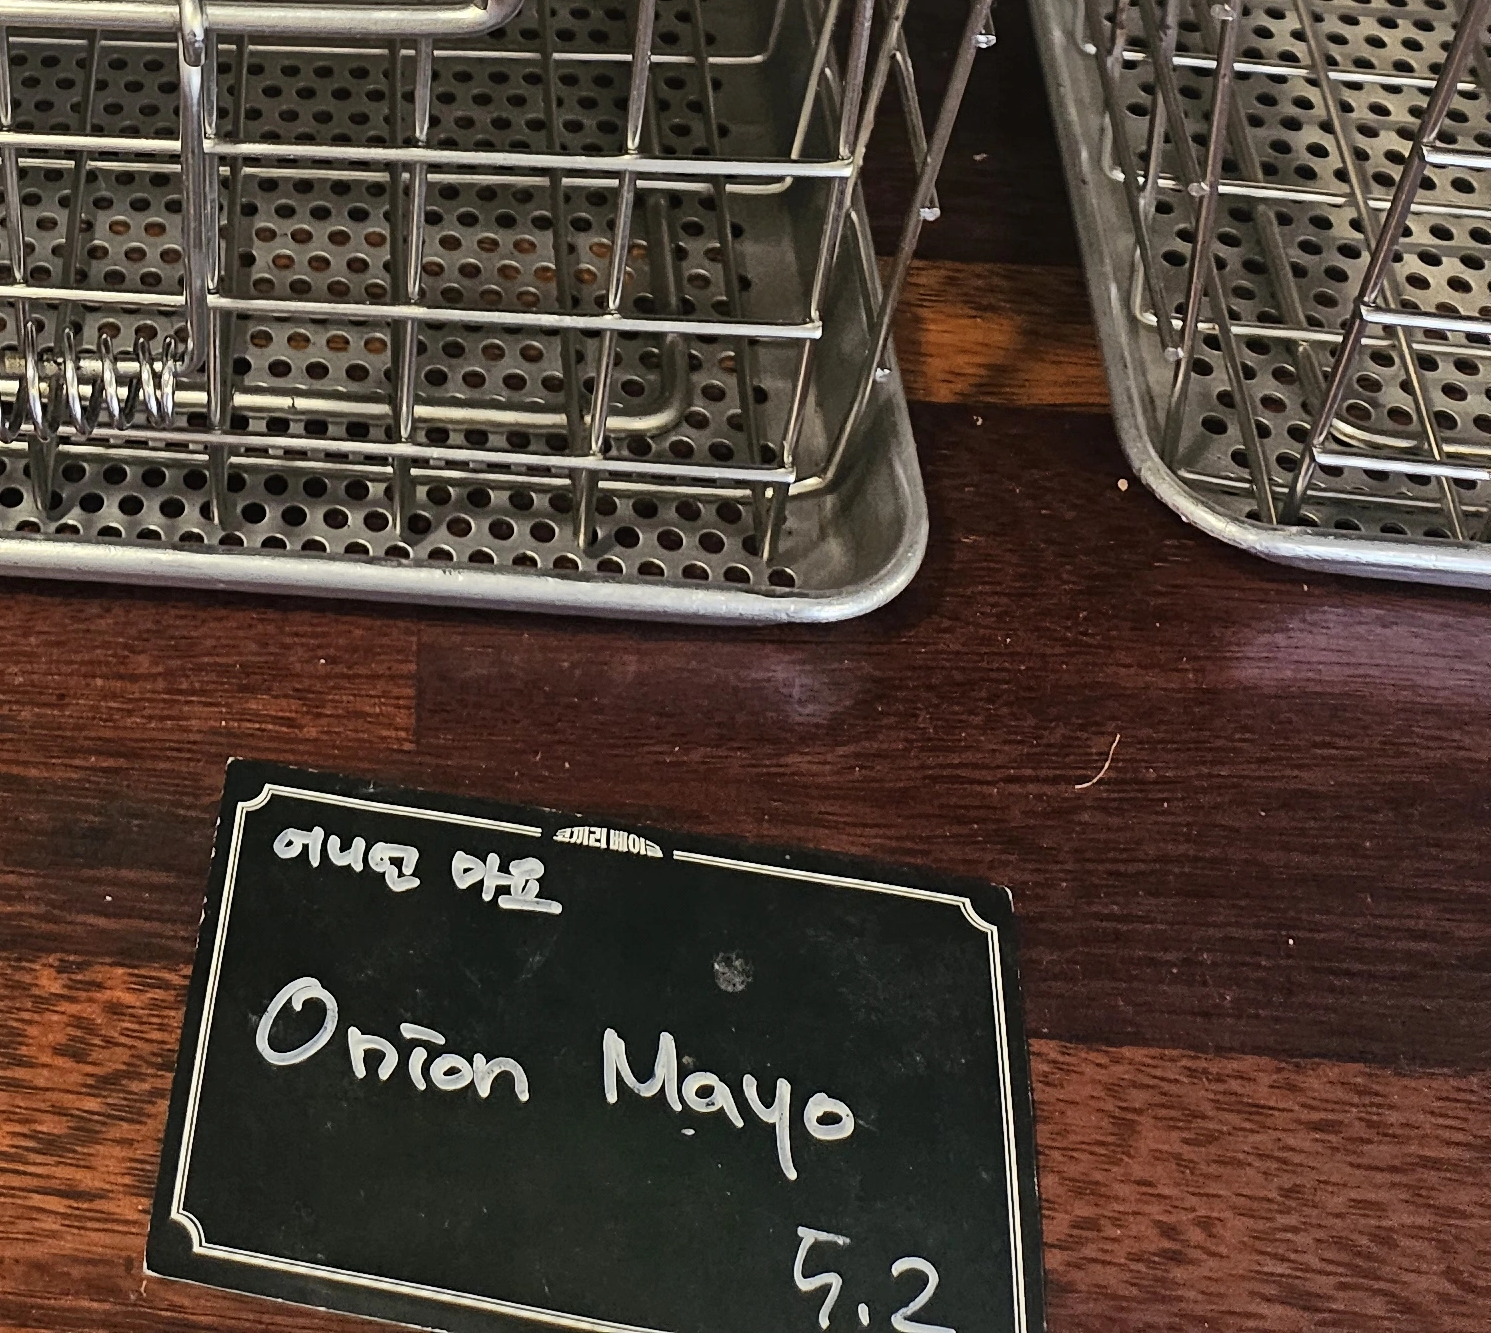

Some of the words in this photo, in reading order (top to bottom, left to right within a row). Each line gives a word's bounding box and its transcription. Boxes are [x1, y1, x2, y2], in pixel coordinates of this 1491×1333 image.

[273, 826, 421, 892] 어니언
[451, 851, 563, 914] 마요
[255, 976, 529, 1102] Onion
[603, 1028, 855, 1181] Mayo
[793, 1226, 957, 1333] 5.2
